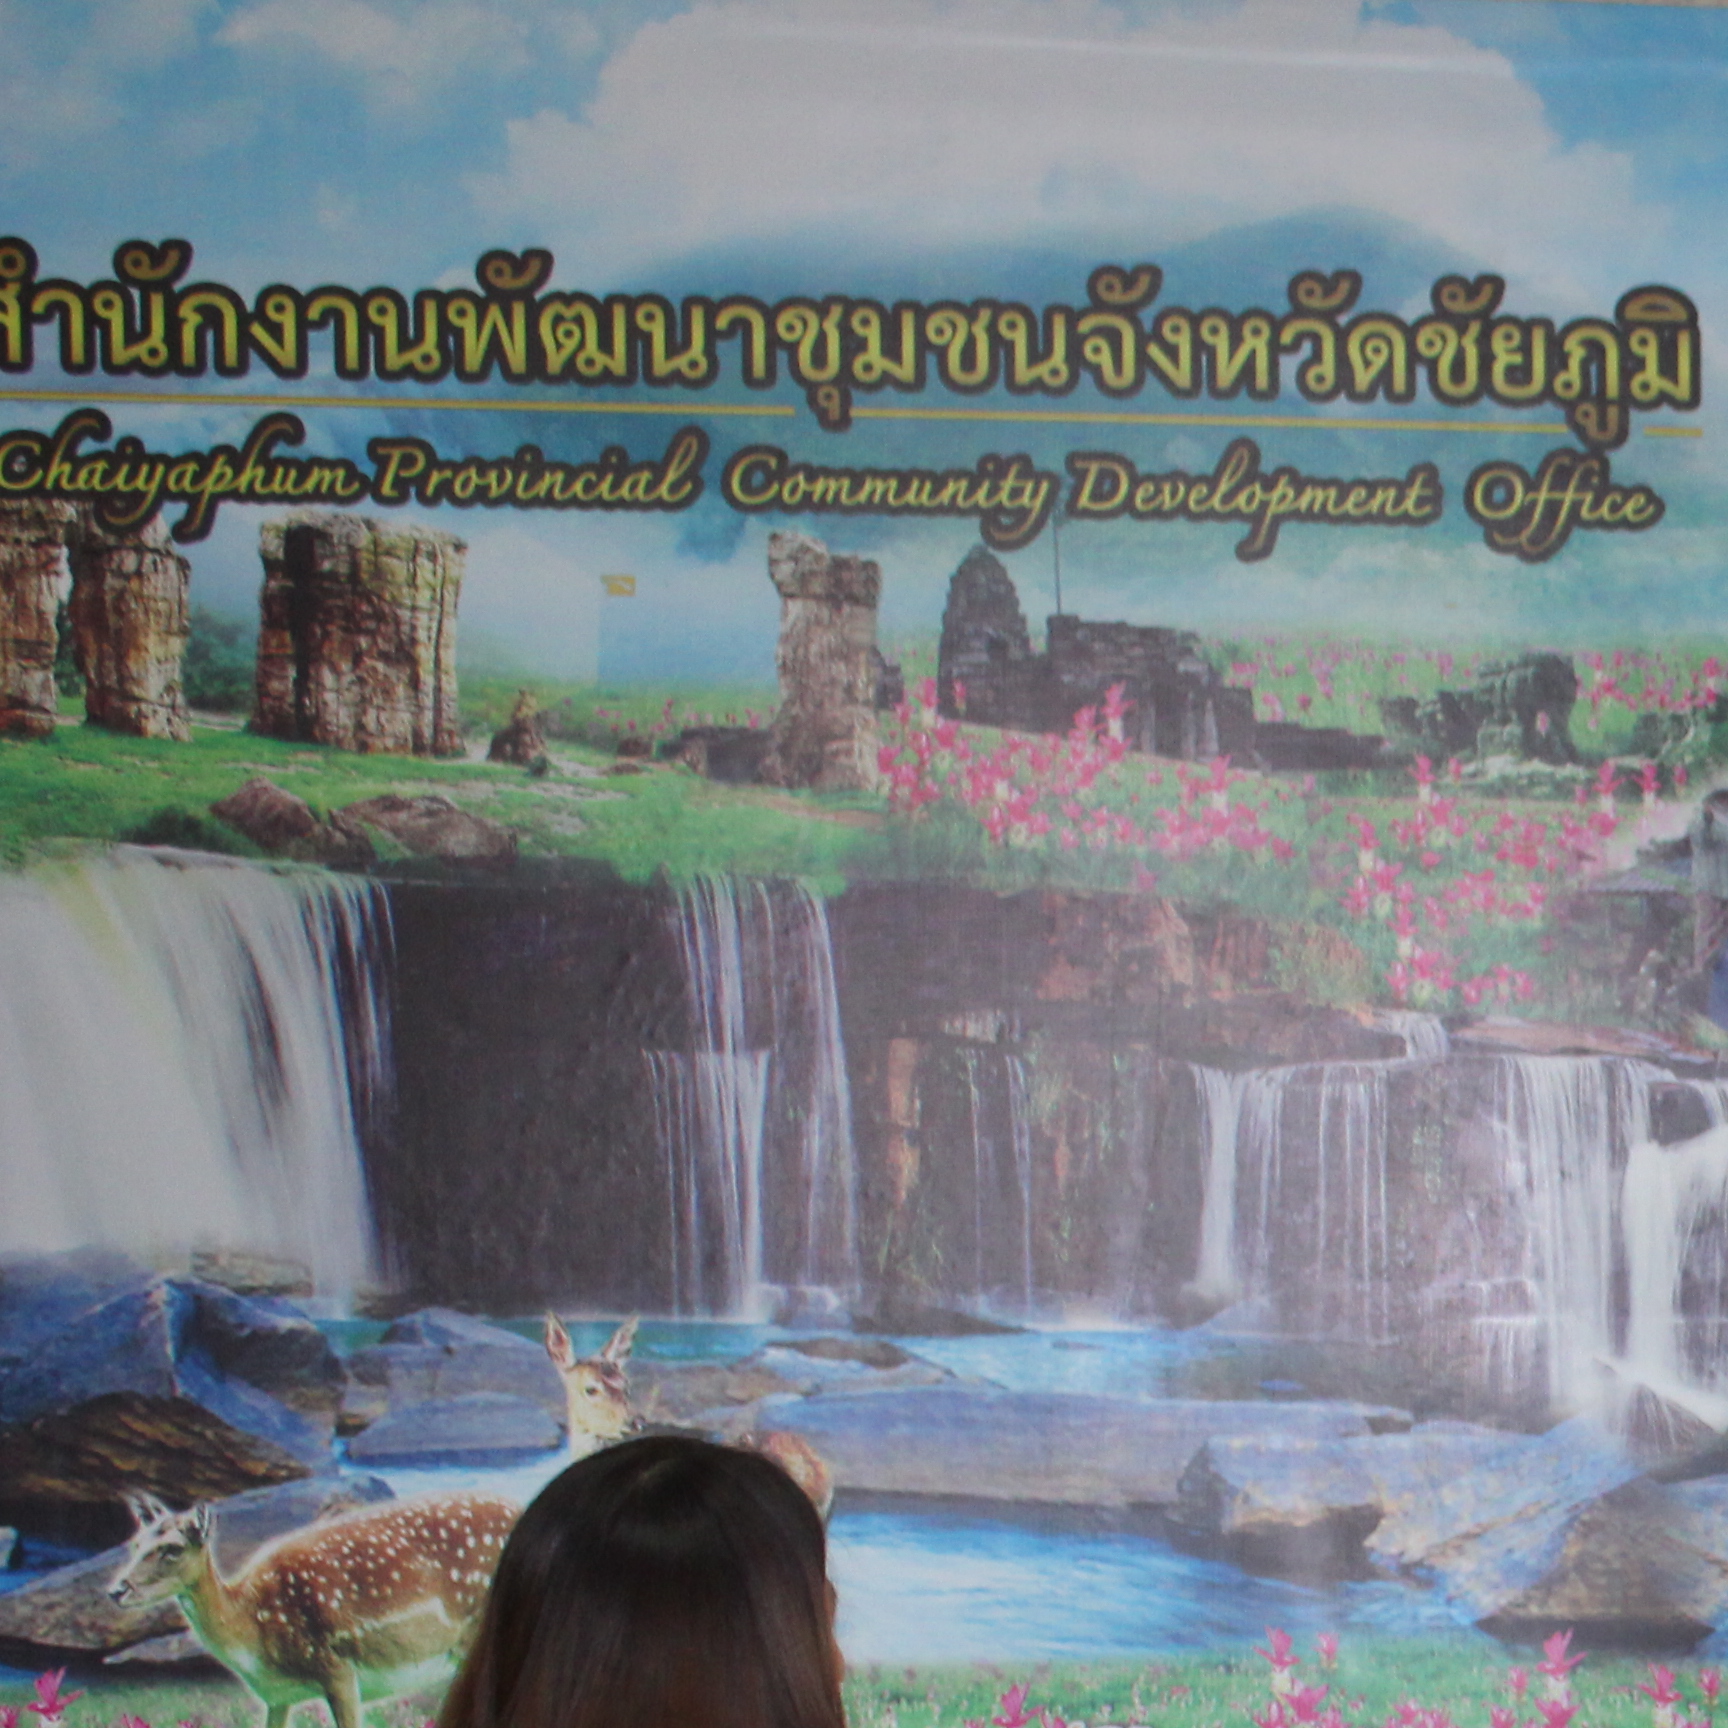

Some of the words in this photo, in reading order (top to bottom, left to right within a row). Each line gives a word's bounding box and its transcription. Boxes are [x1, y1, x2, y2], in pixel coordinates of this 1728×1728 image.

[0, 412, 362, 538] Chaiyaphum
[371, 430, 702, 508] Provincial
[730, 448, 1052, 546] Community
[1067, 441, 1440, 558] Development
[1467, 451, 1660, 558] Office
